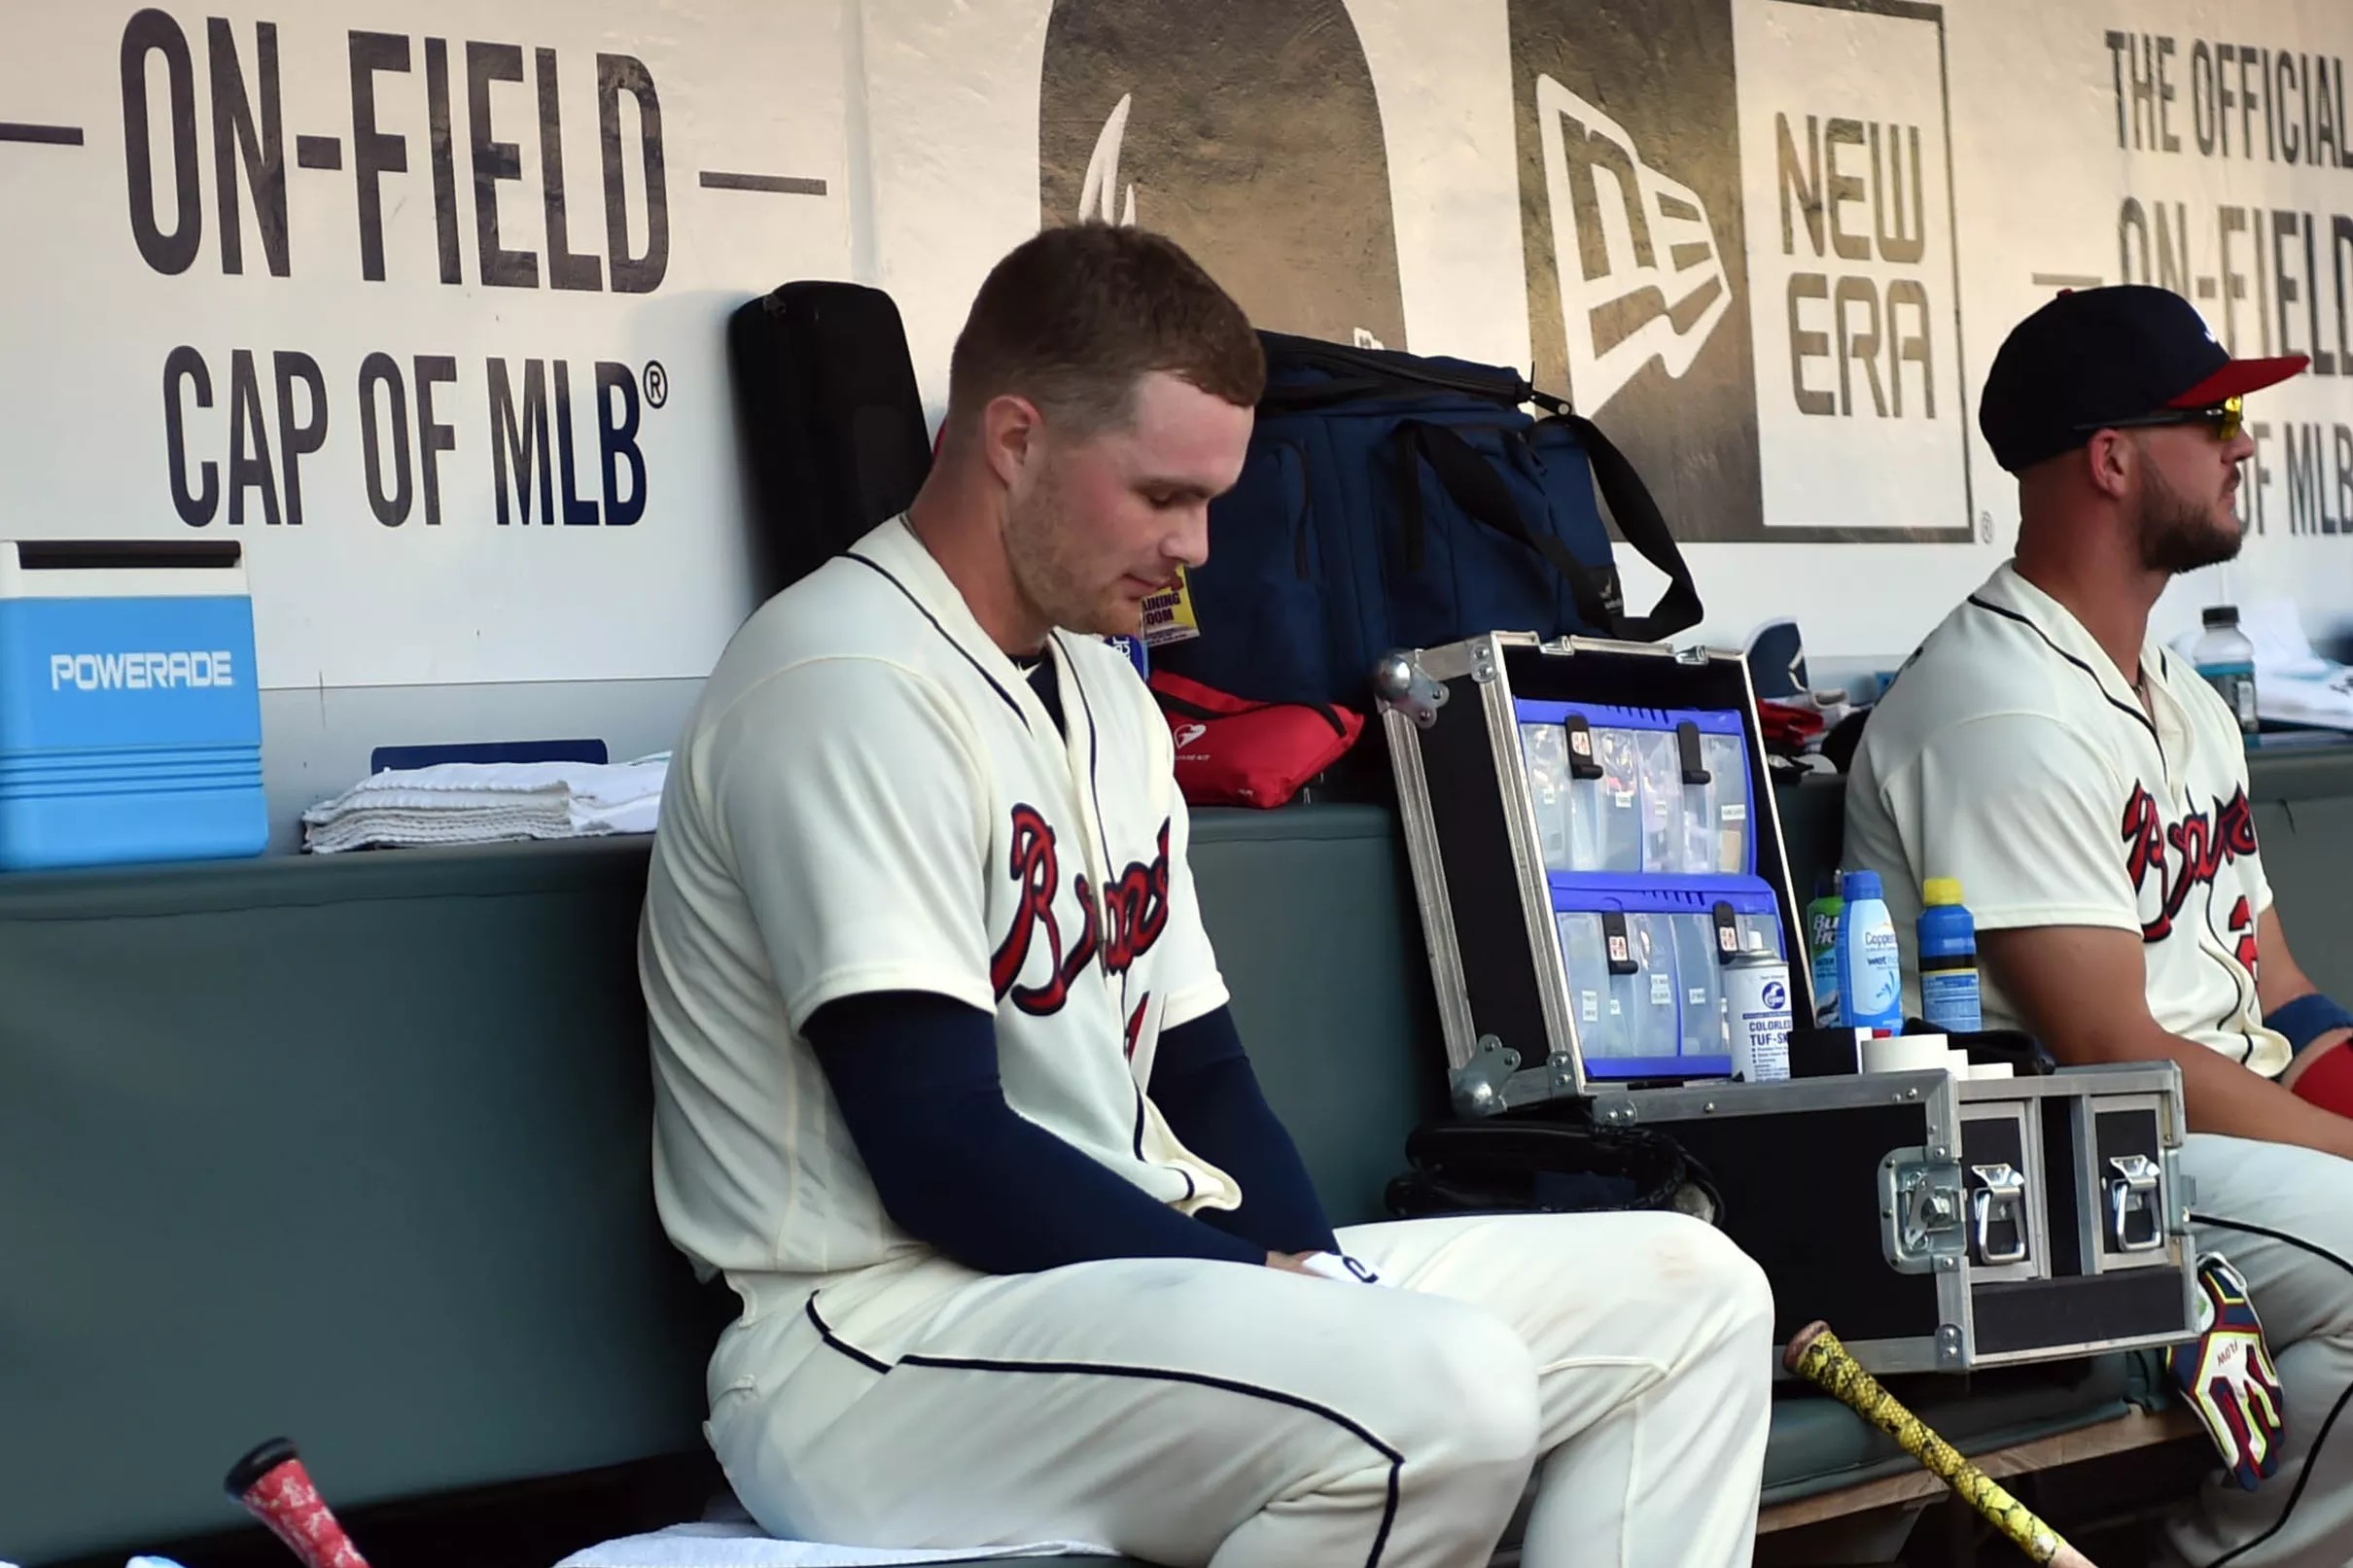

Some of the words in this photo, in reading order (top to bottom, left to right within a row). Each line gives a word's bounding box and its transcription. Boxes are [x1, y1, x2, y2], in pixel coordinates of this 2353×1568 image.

[120, 8, 669, 294] ON-FIELD
[2104, 30, 2180, 153] THE
[2190, 38, 2353, 168] OFFICIAL
[1776, 112, 1923, 263] NEW
[1789, 272, 1935, 418] ERA
[162, 345, 329, 527] CAP
[358, 351, 456, 526] OF
[51, 651, 233, 690] POWERADE
